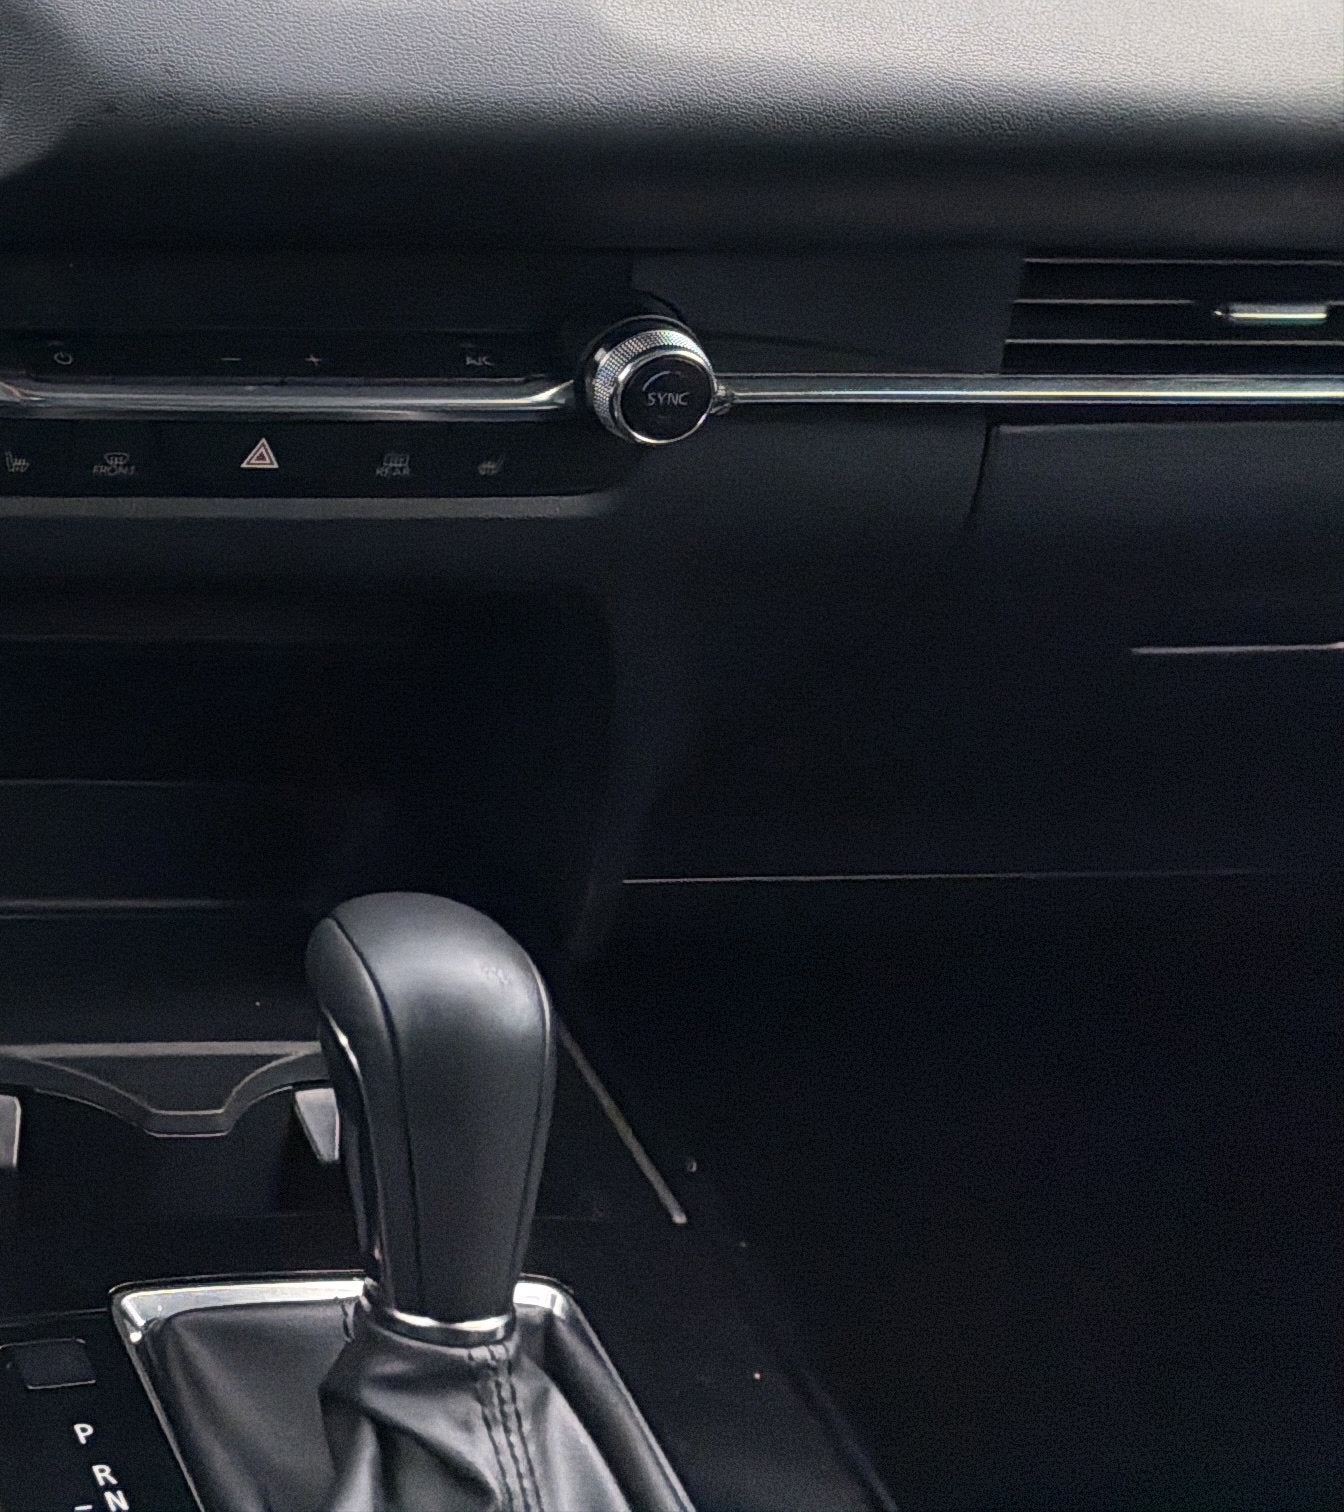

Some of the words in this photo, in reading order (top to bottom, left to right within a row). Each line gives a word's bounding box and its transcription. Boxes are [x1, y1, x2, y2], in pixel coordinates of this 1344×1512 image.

[646, 391, 691, 408] SYNC
[73, 1422, 94, 1445] P
[91, 1464, 119, 1487] R
[103, 1489, 130, 1512] N
